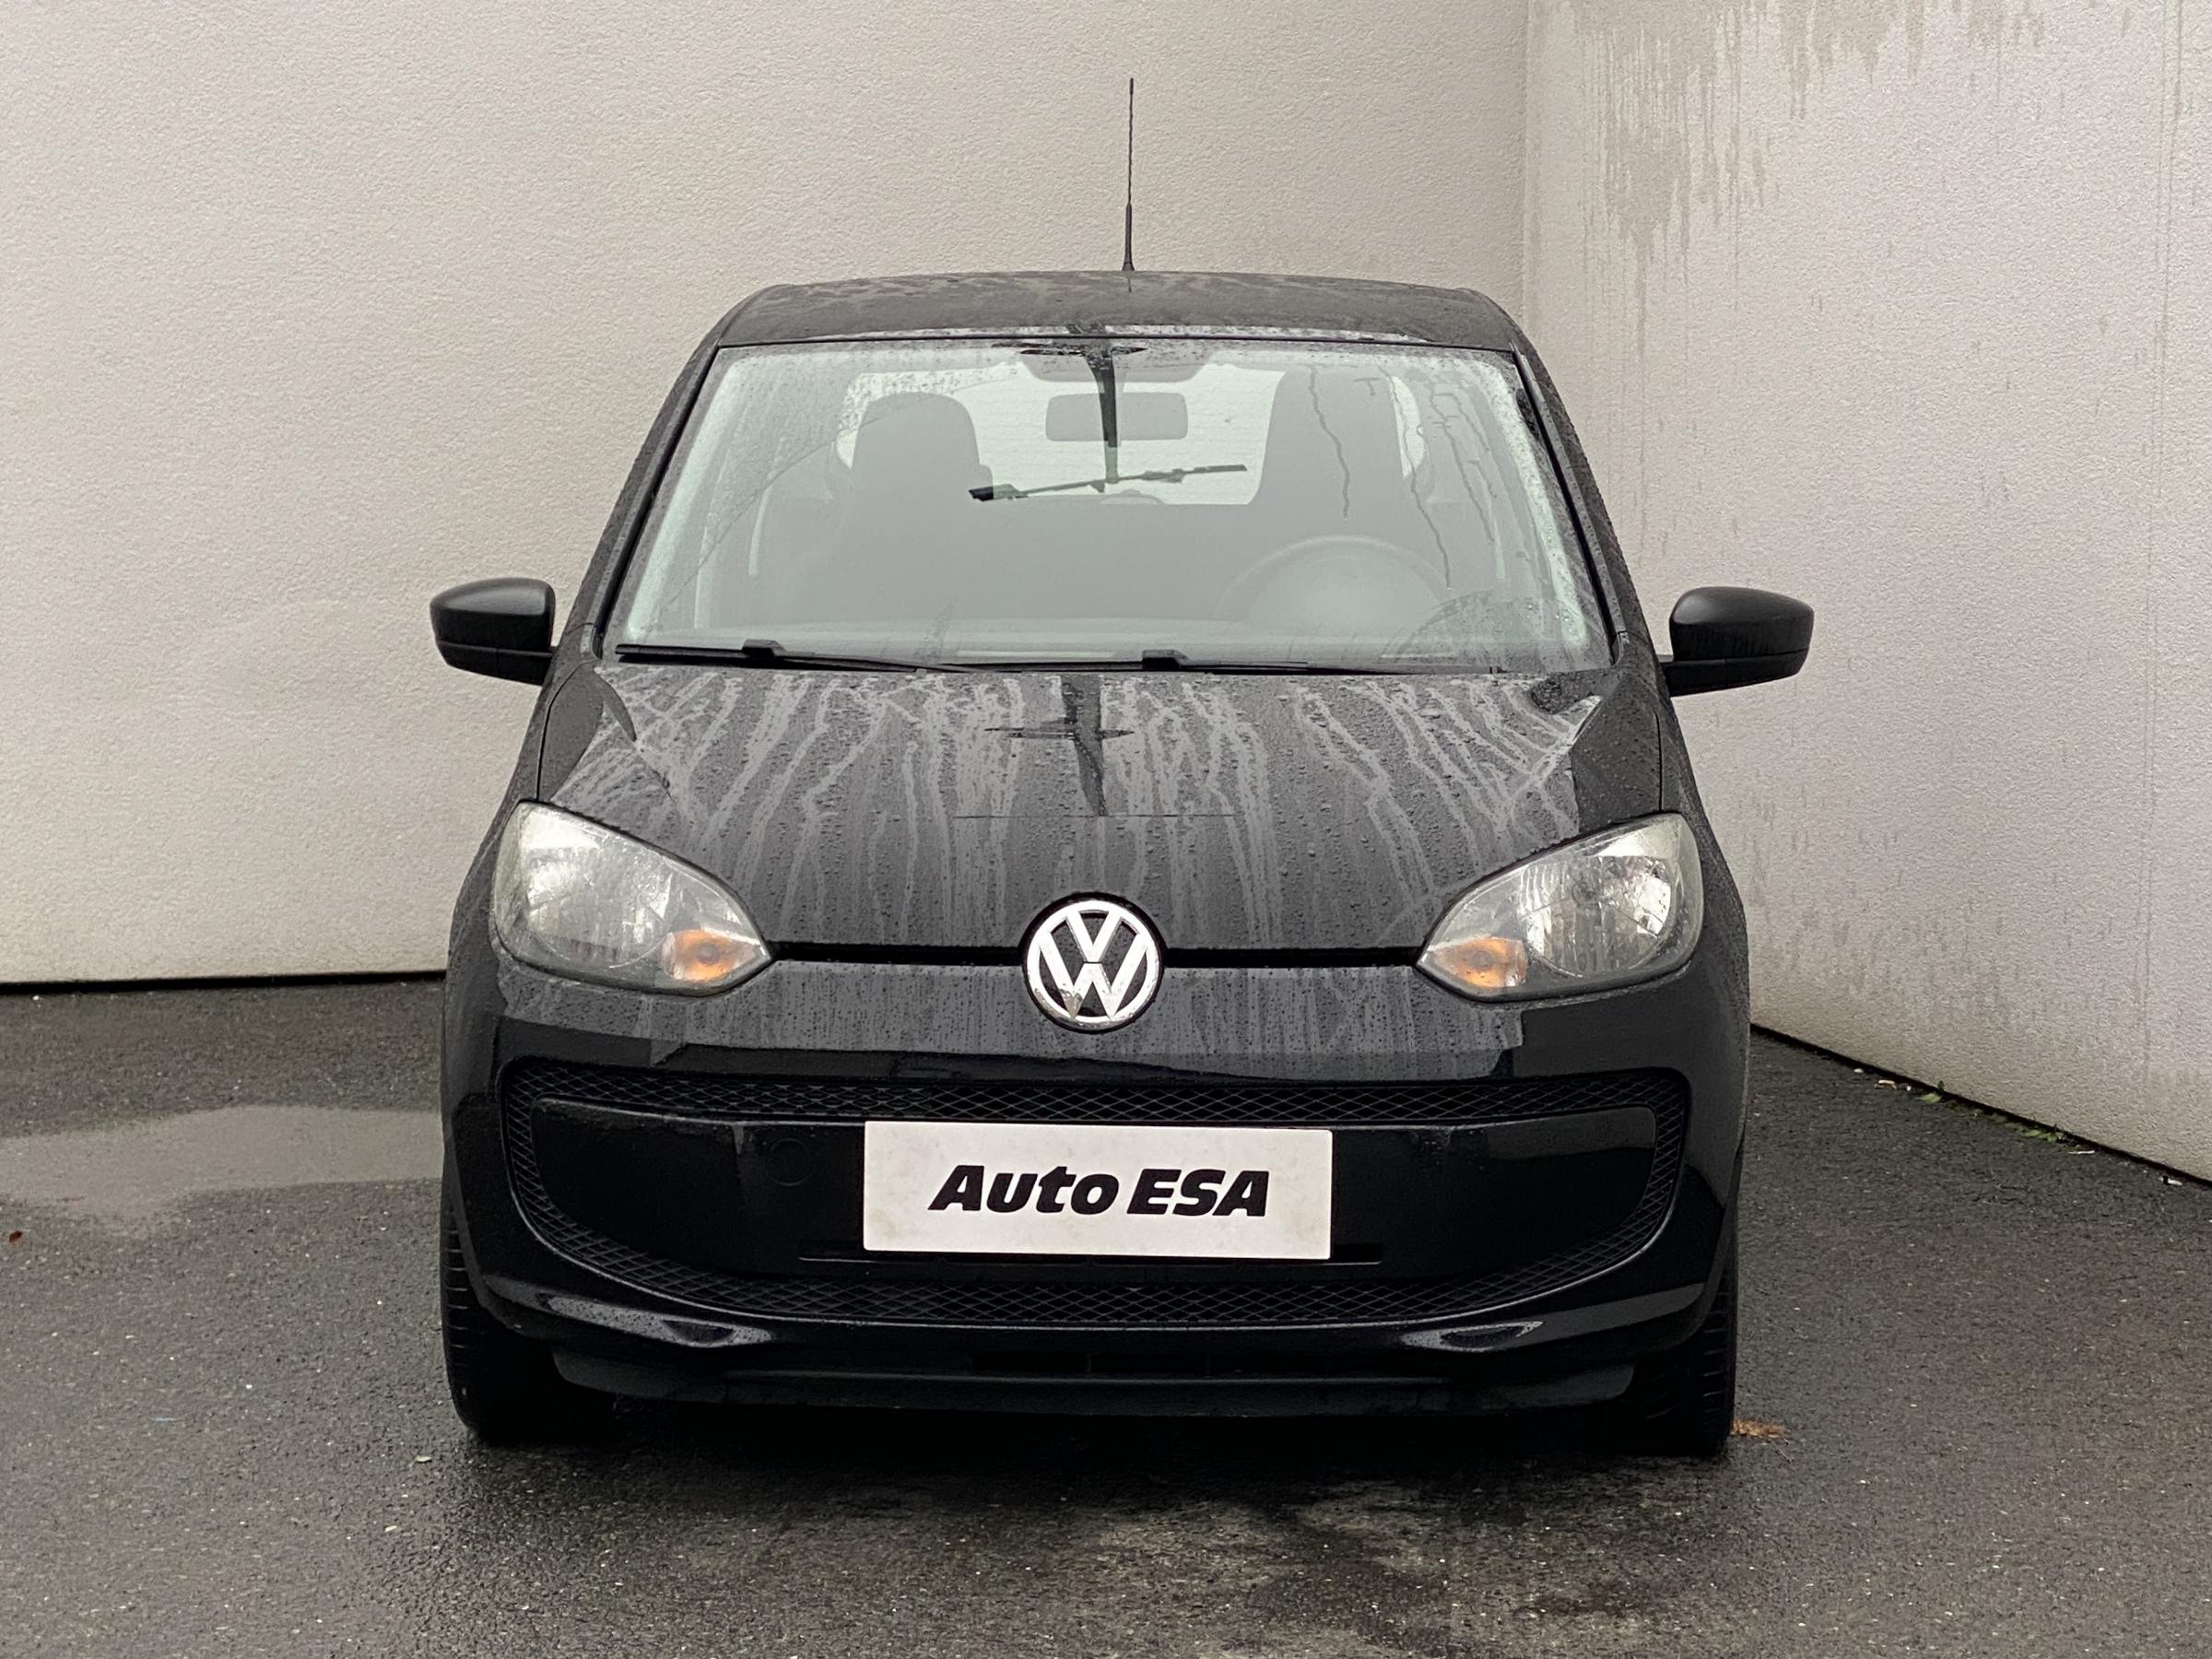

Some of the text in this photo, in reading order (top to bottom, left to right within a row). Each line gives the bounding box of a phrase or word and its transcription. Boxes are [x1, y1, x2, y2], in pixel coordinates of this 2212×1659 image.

[1030, 902, 1157, 1024] VW
[927, 1164, 1270, 1218] Auto ESA
